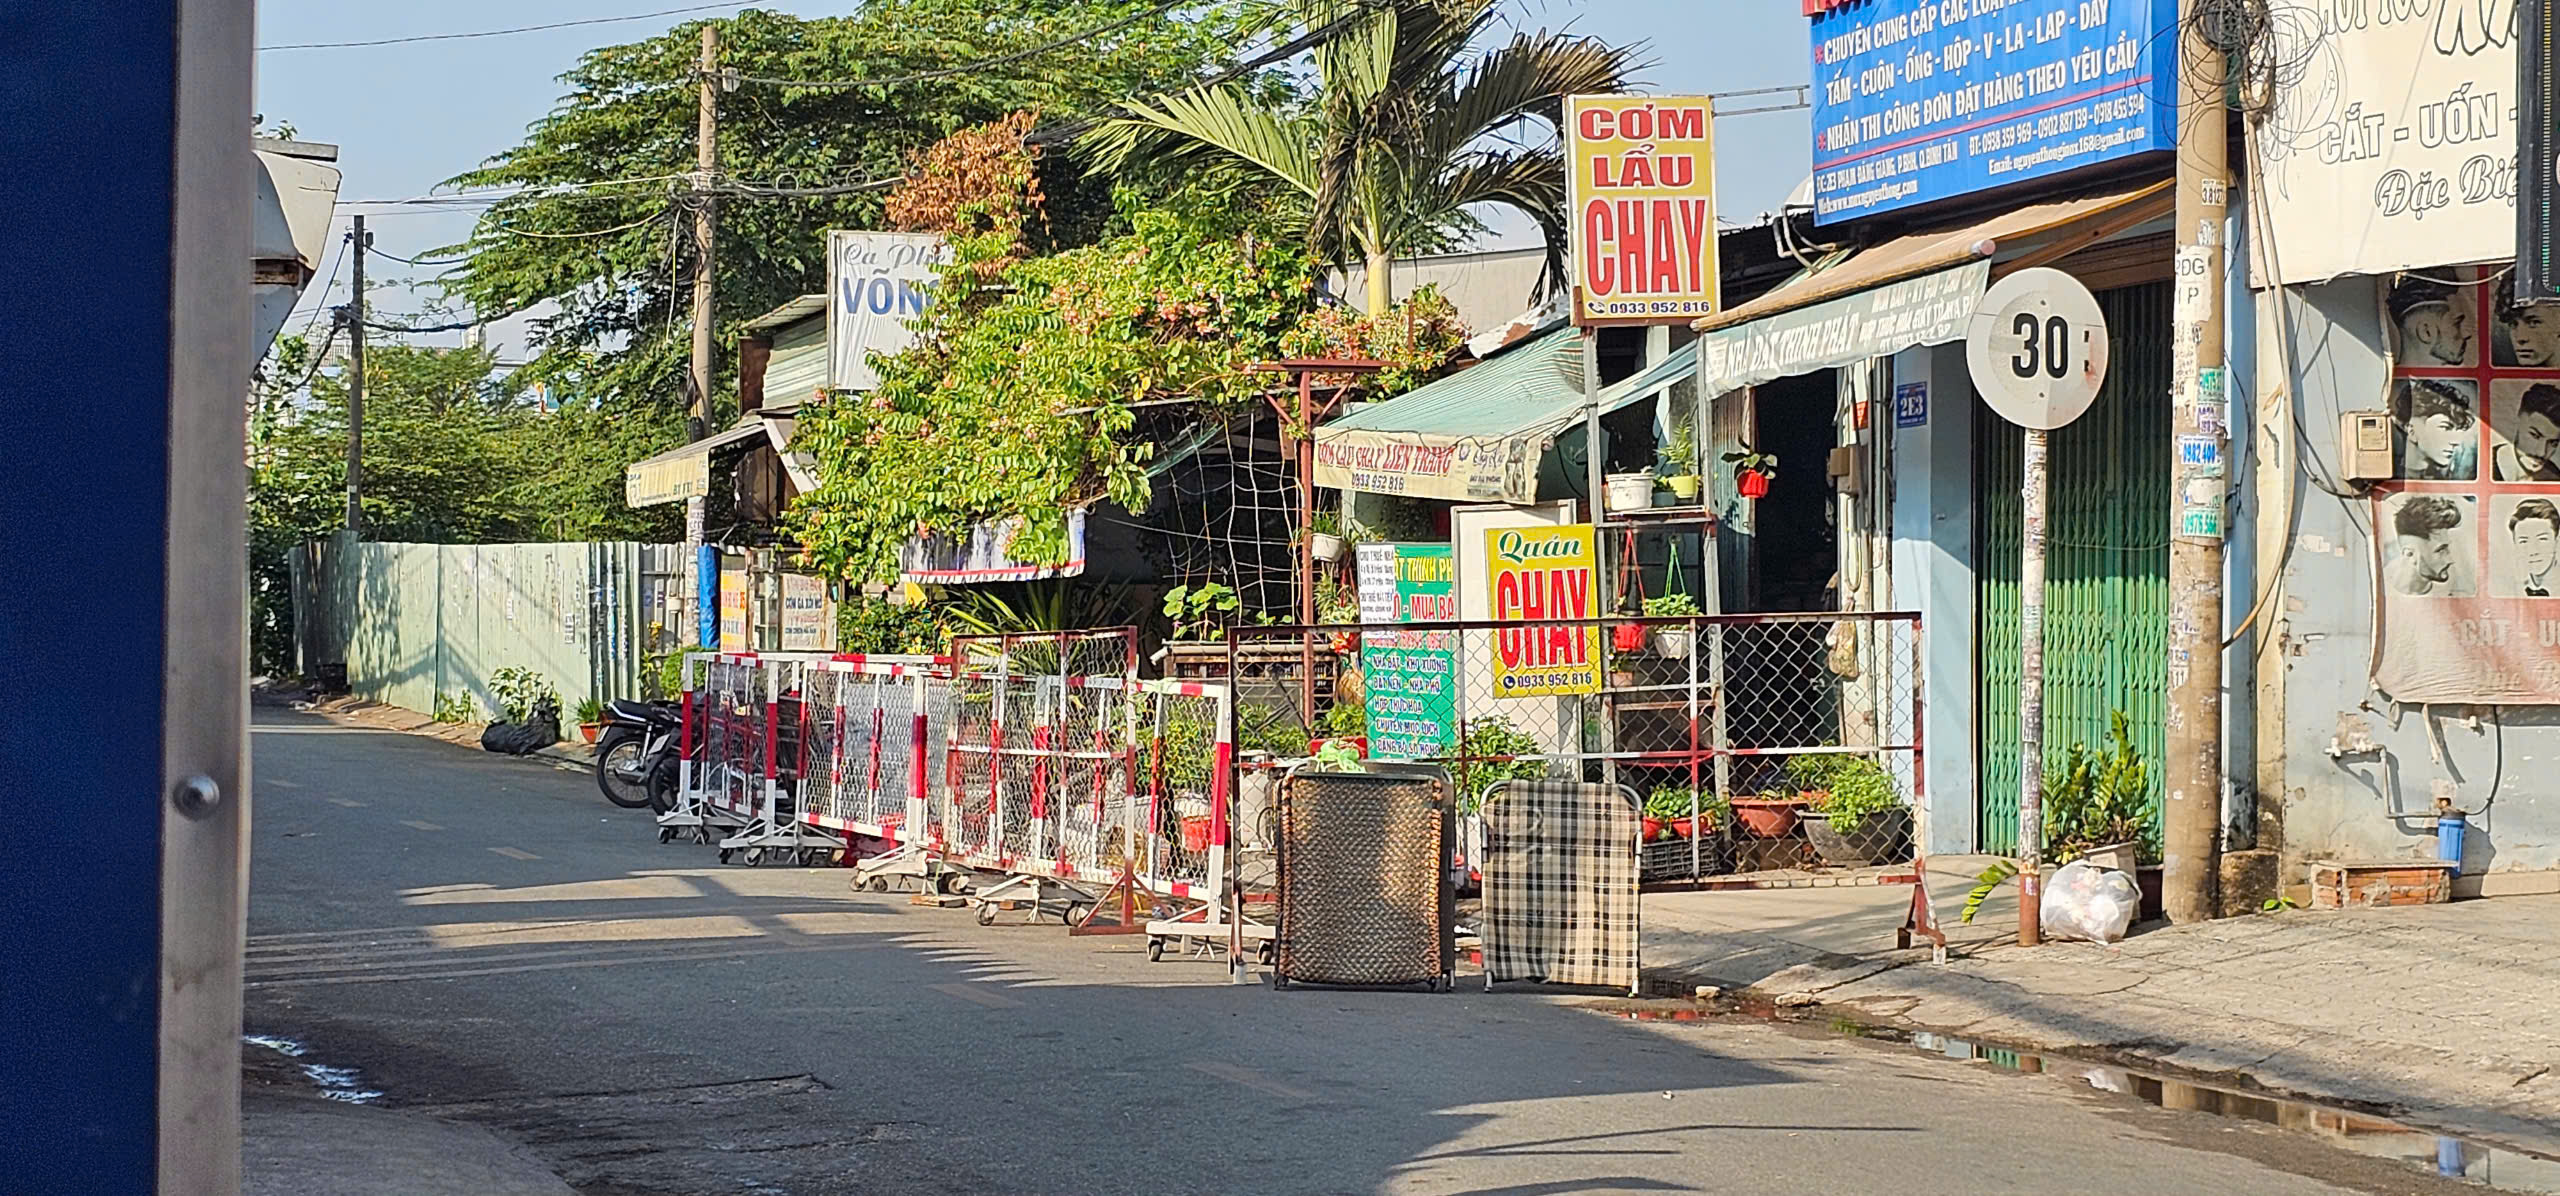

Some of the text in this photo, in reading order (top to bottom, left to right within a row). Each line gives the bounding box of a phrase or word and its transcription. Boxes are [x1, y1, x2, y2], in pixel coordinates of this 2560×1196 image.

[1824, 22, 1871, 65] CHUYÊN
[1873, 14, 1908, 49] CUNG
[1826, 68, 1851, 106] TẤM
[1861, 59, 1894, 99] CUỘN
[1905, 45, 1933, 83] ỐNG
[1943, 35, 1972, 76] HỘP
[1983, 32, 1993, 60] V
[2005, 23, 2024, 54] LA
[2036, 9, 2066, 44] LAP
[1827, 115, 1859, 154] NHẬN
[1861, 113, 1881, 142] THI
[1884, 99, 1920, 135] CÔNG
[1923, 91, 1952, 125] ĐƠN
[1955, 81, 1981, 120] ĐẶT
[1983, 71, 2024, 109] HÀNG
[2027, 60, 2066, 96] THEO
[2071, 46, 2102, 84] YÊU
[1579, 104, 1704, 140] CƠM
[2017, 121, 2032, 144] 969
[2319, 102, 2384, 165] CẮT
[2419, 82, 2498, 148] UỐN
[1593, 144, 1693, 187] LẨU
[2375, 169, 2450, 220] Đặc
[1586, 199, 1706, 296] CHAY
[1610, 301, 1710, 314] 0933 952 816
[1818, 303, 1860, 358] PHÁT
[2012, 313, 2068, 378] 30
[1900, 395, 1924, 417] 2E3
[1356, 446, 1384, 470] CHAY
[1412, 444, 1456, 475] TRANG
[1351, 472, 1405, 492] 0933 952 816
[1500, 531, 1582, 564] Quán
[1411, 595, 1435, 620] MUA
[1497, 569, 1590, 671] CHAY
[1518, 672, 1592, 687] 0933 952 816
